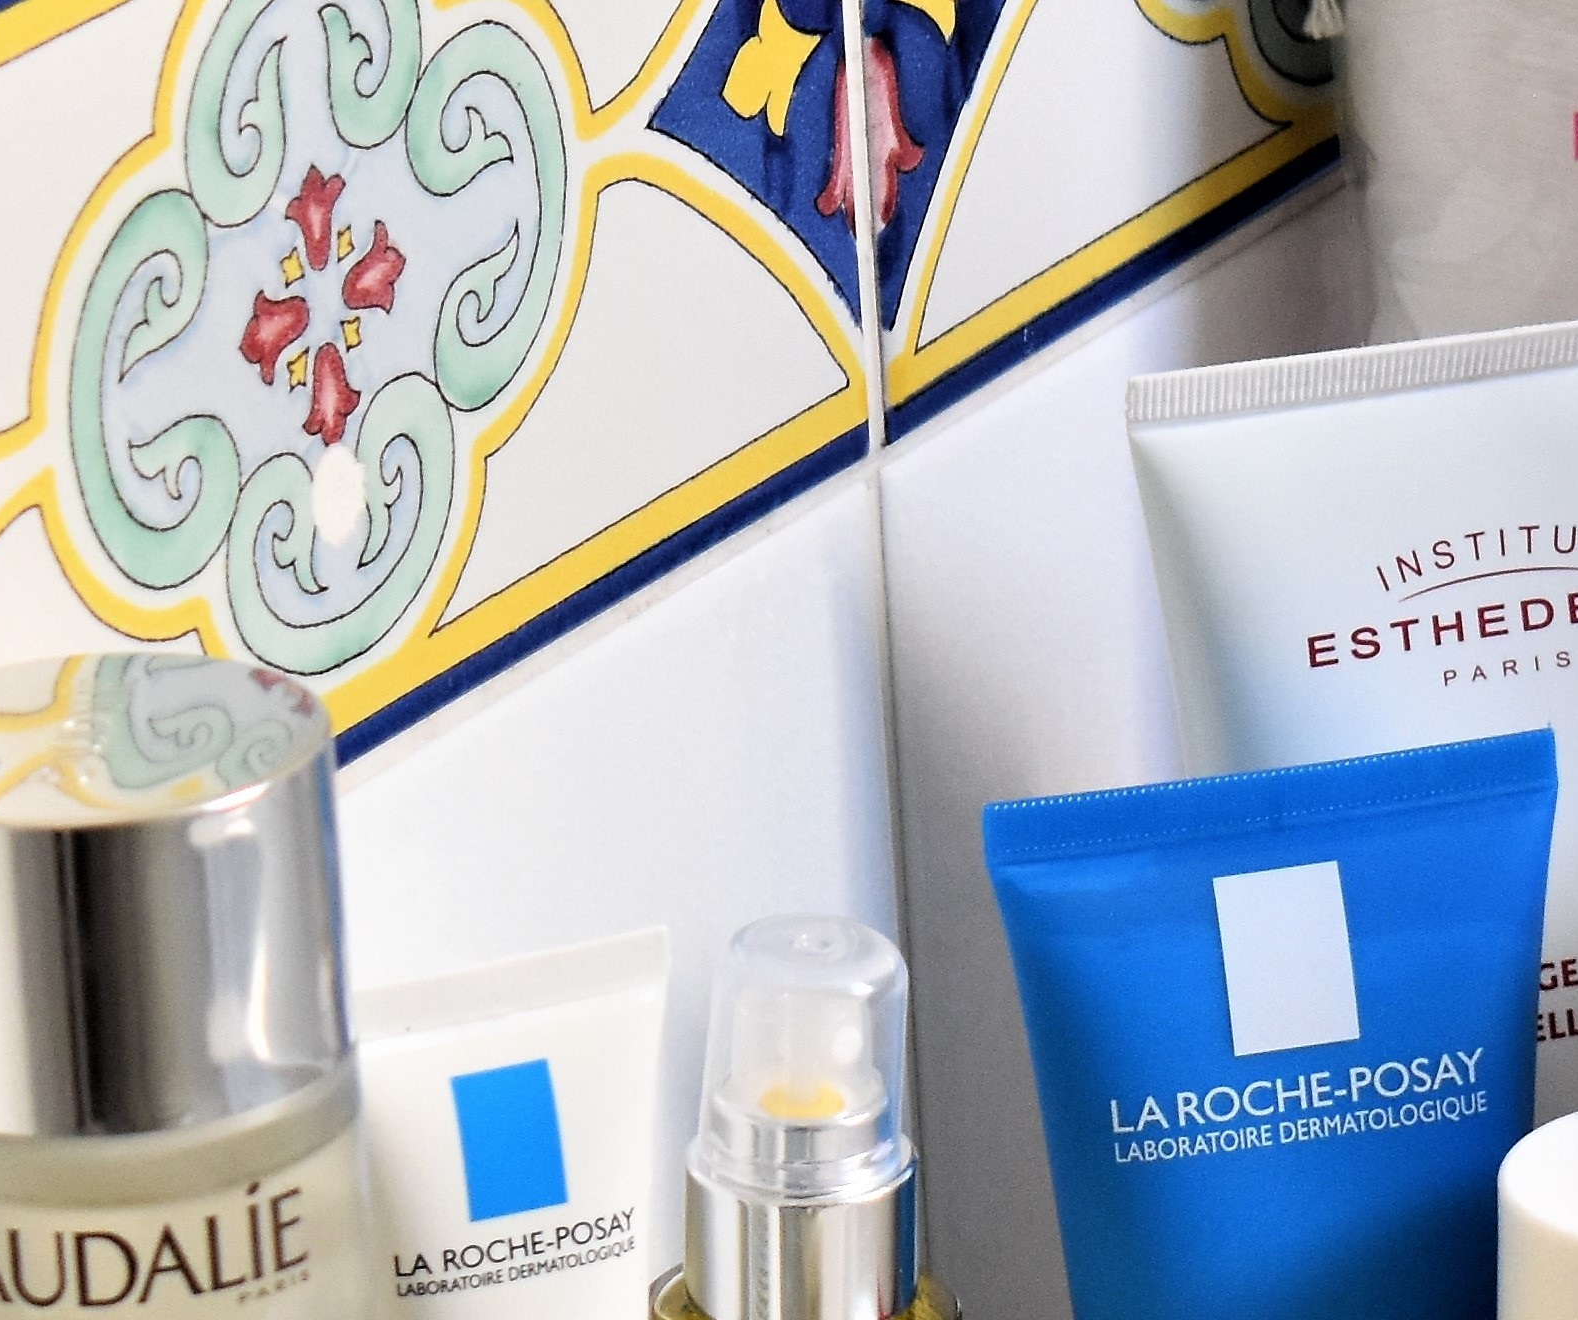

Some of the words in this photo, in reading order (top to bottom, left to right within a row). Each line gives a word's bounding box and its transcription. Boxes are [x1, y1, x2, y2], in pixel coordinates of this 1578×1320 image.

[1442, 650, 1572, 687] PARIS
[1109, 1097, 1169, 1135] LA
[1176, 1046, 1485, 1127] ROCHE-POSAY
[1114, 1125, 1274, 1164] LABORATOIRE
[1279, 1090, 1488, 1145] DERMATOLOGIQUE
[394, 1253, 433, 1278] LA
[441, 1207, 636, 1273] ROCHE-POSAY
[396, 1268, 504, 1298] LABORATOIRE
[507, 1235, 637, 1282] DERMATOLOGIQUE
